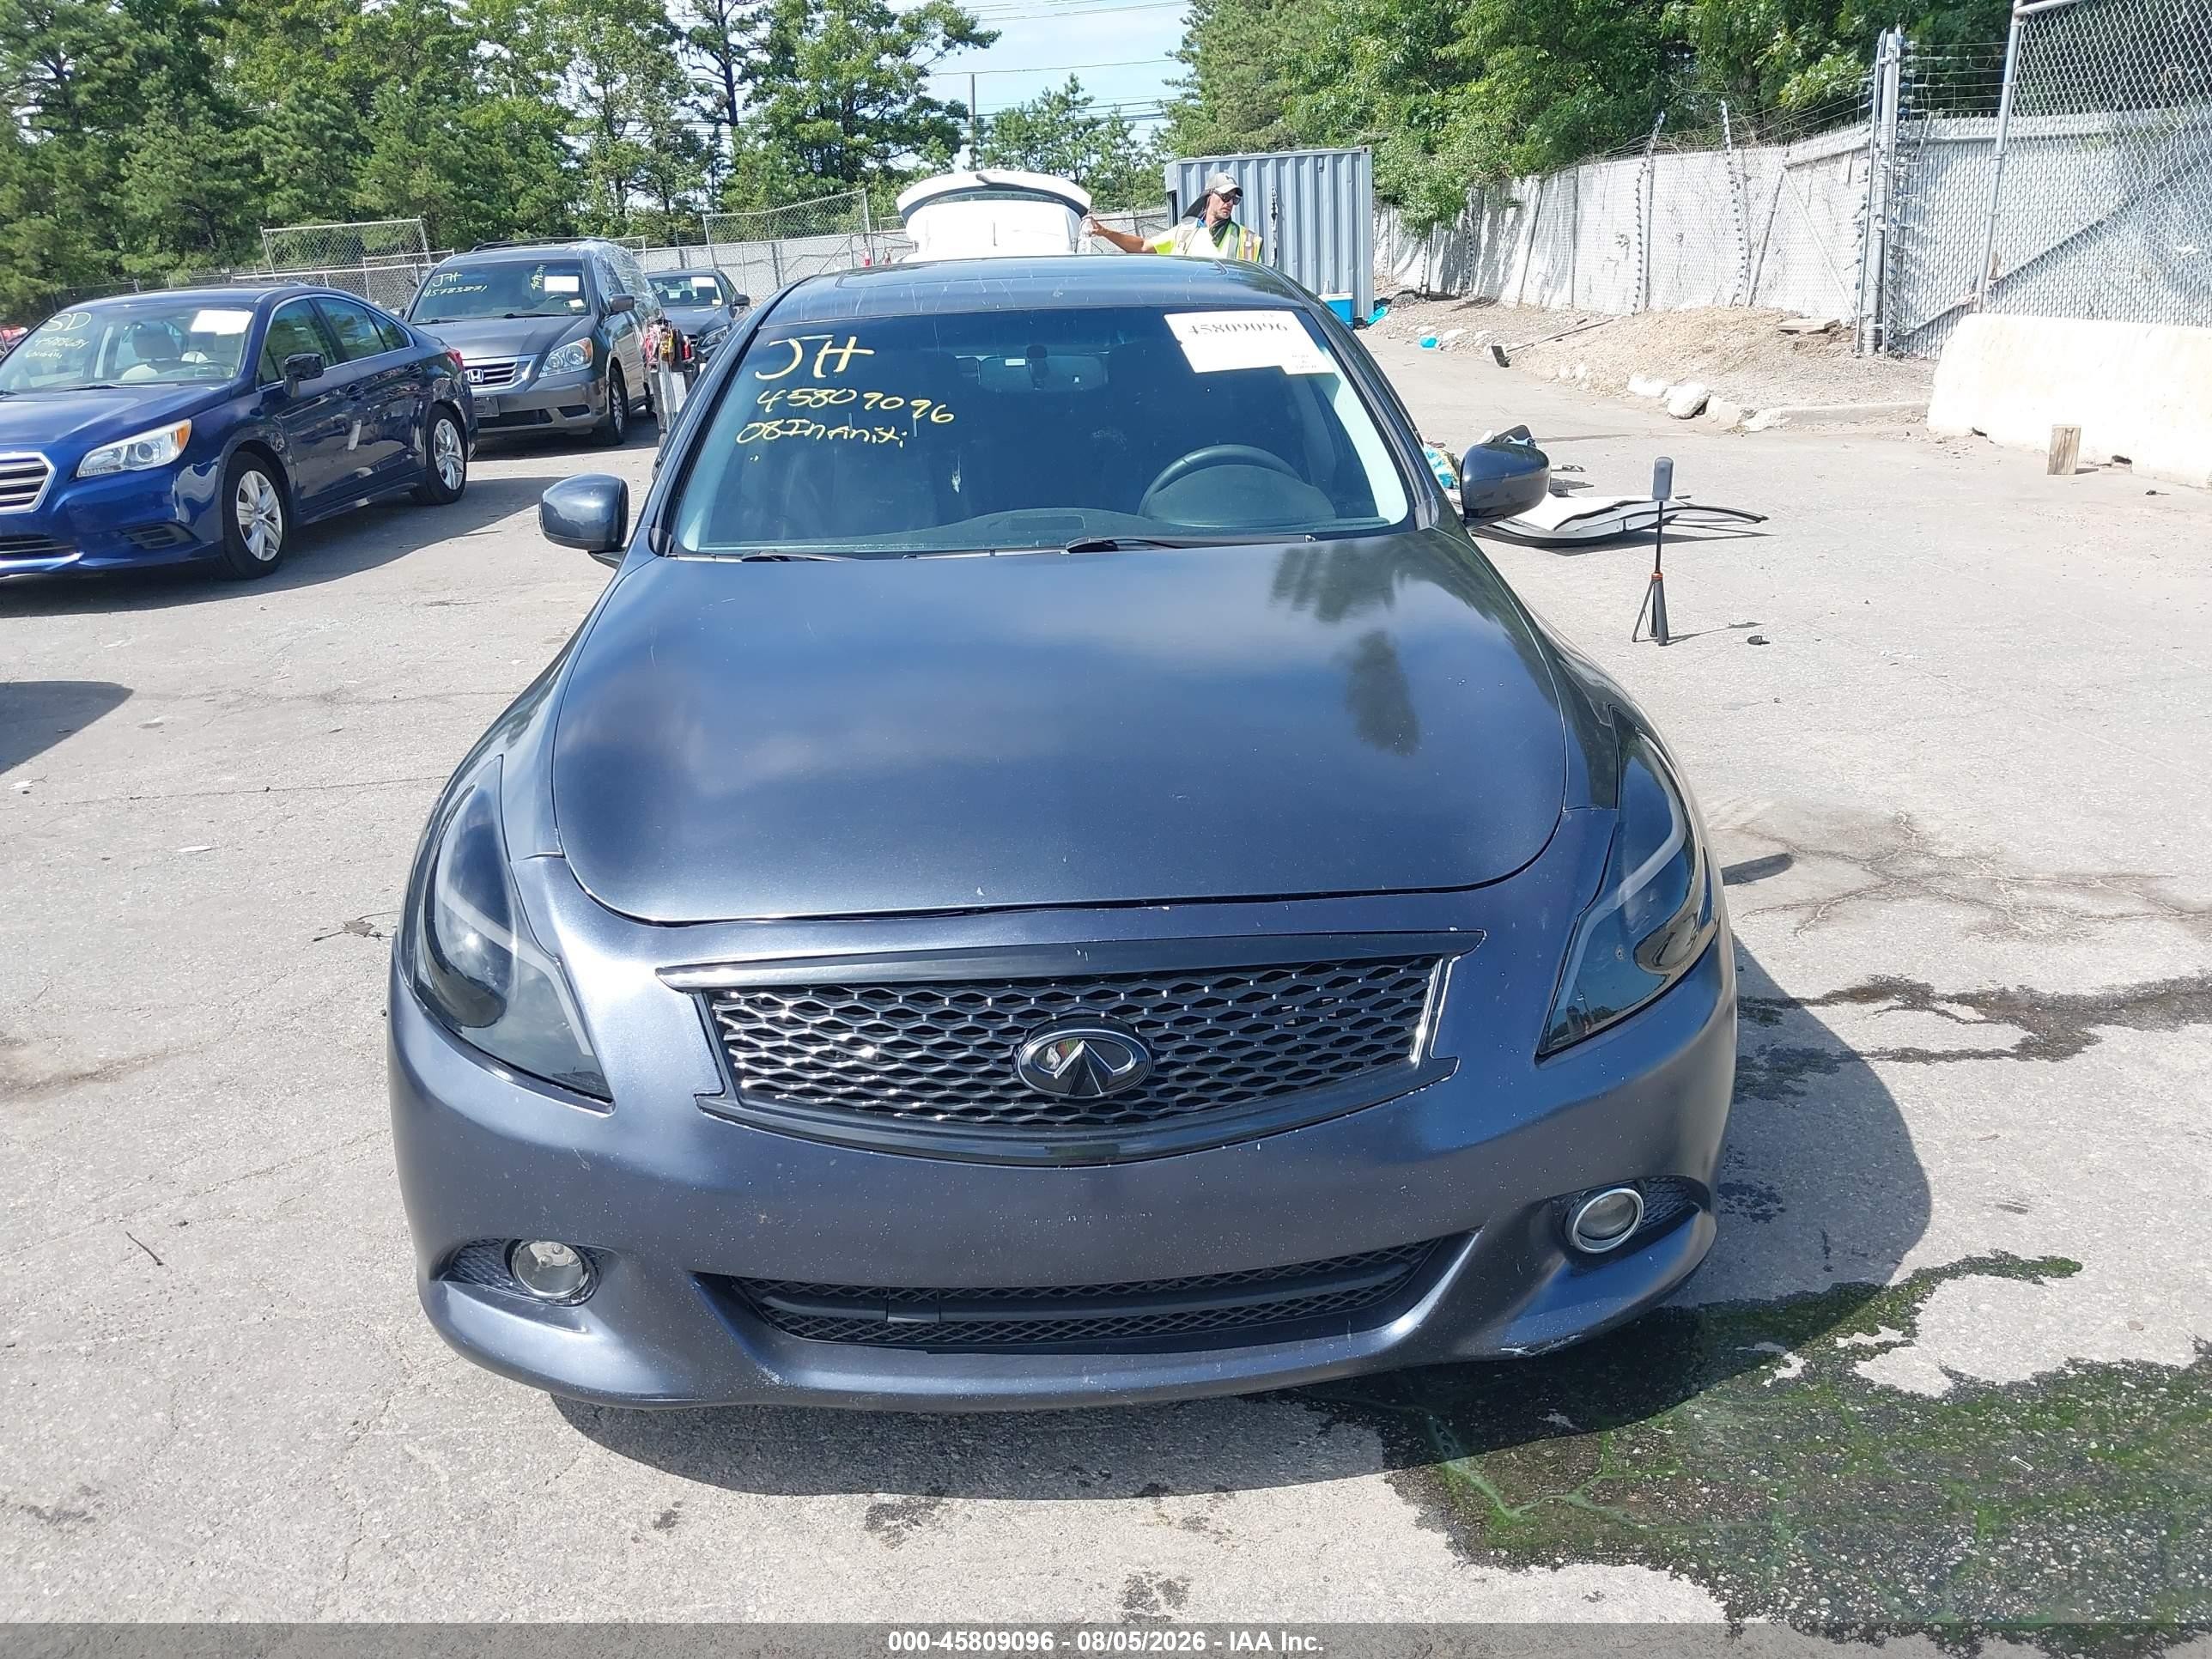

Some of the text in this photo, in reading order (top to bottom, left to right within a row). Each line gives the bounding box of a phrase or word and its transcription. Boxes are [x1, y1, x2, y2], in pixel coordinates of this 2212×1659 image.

[40, 312, 92, 331] SD
[1188, 322, 1289, 335] 45809096
[755, 334, 875, 380] JH
[756, 388, 955, 423] 45809096
